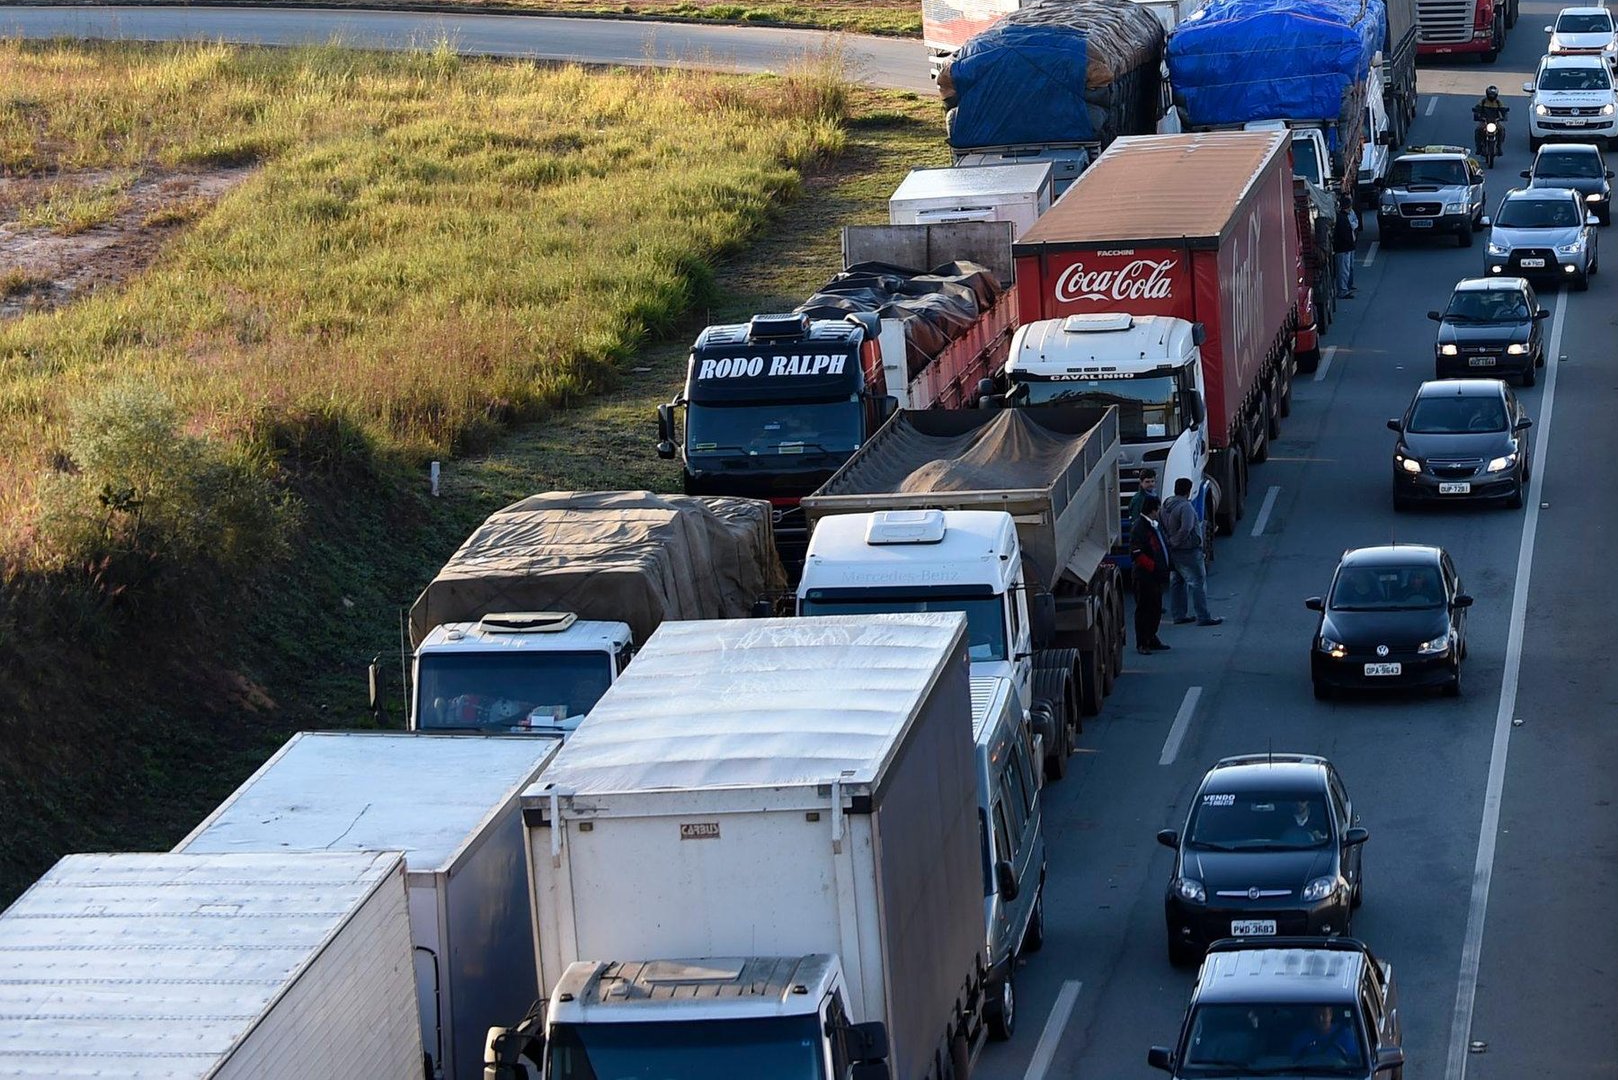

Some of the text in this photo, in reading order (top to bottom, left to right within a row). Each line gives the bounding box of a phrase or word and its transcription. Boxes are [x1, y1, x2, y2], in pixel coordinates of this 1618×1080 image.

[1097, 249, 1135, 257] FACCHINI
[1055, 259, 1178, 303] Coca-Cola
[699, 354, 848, 380] RODO RALPH
[1050, 373, 1134, 381] CAVALINHO
[841, 569, 960, 583] Mercedes-Benz
[681, 824, 720, 835] CARBUS
